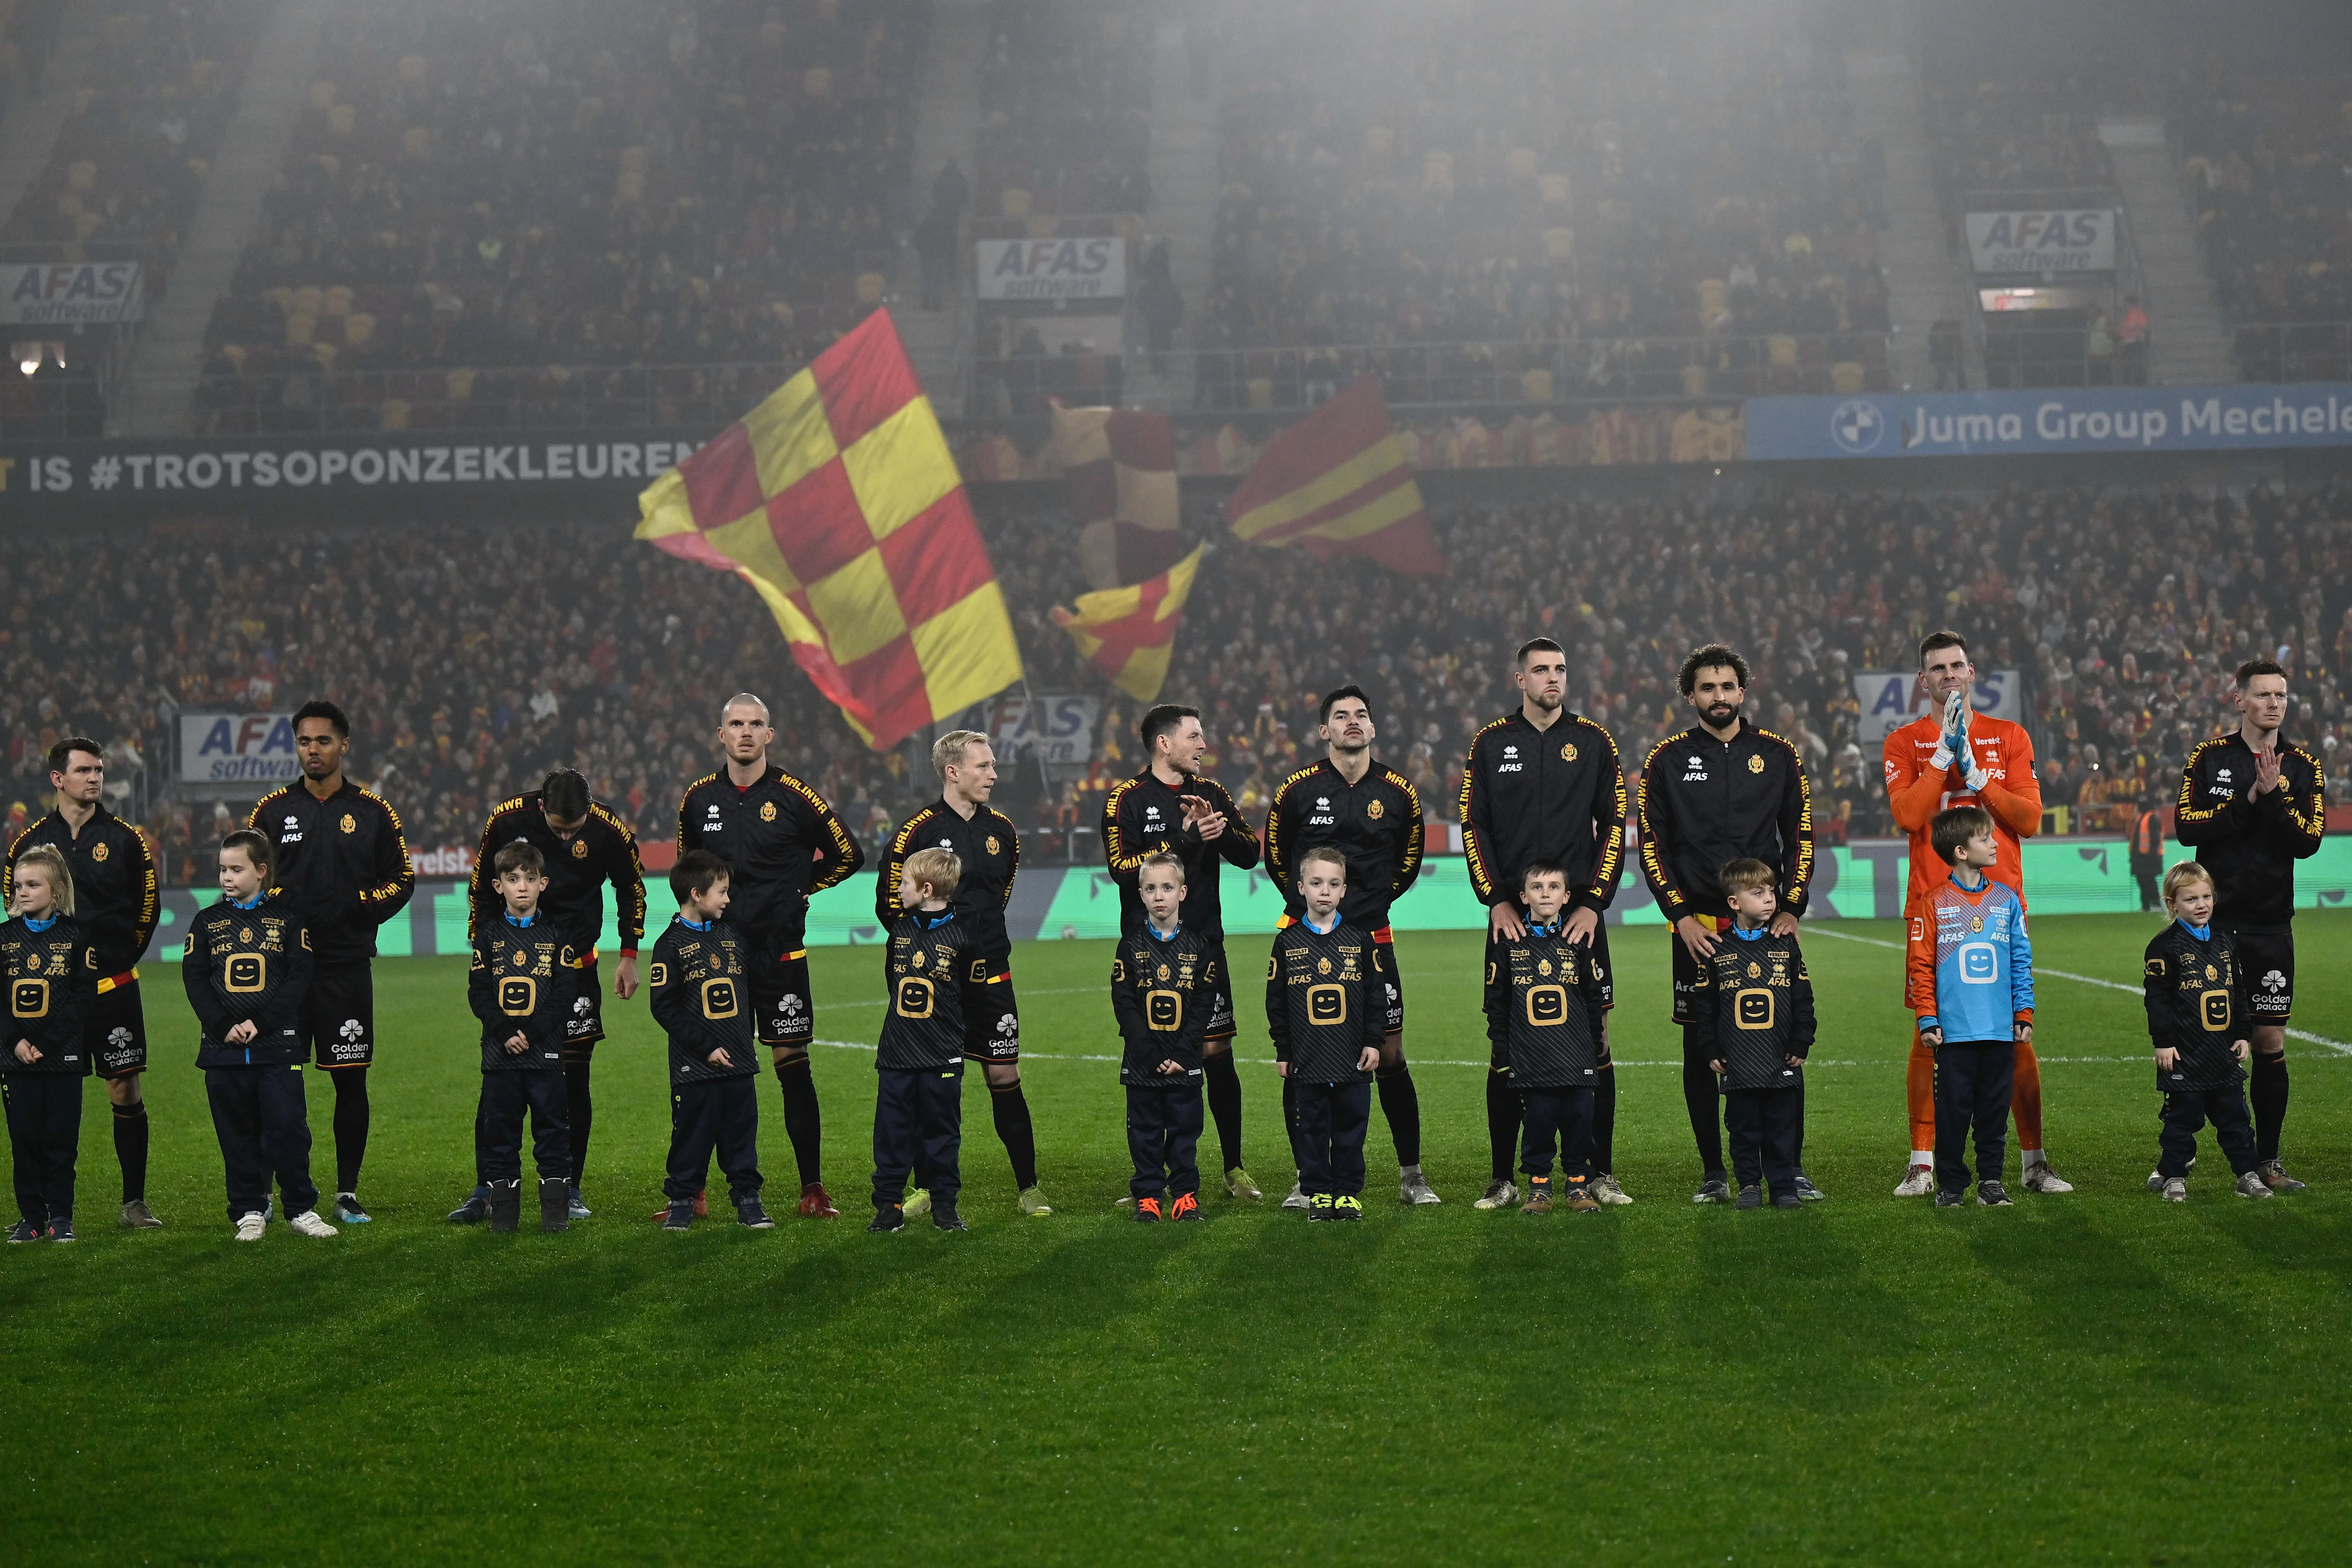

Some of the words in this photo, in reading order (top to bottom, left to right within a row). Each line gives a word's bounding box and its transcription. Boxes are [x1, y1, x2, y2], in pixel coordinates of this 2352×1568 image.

[1983, 214, 2100, 249] AFAS
[993, 241, 1110, 276] AFAS
[11, 266, 129, 303] AFAS
[21, 301, 121, 324] software
[1907, 404, 2022, 448] Juma
[2037, 401, 2167, 445] Group
[29, 455, 73, 492] IS
[1872, 674, 2005, 716] AFS
[198, 717, 296, 756] AFA
[1974, 736, 2002, 745] Verelst.
[1498, 763, 1523, 773] AFAS
[1683, 772, 1708, 782] AFAS
[1274, 765, 1319, 805] MALINWA
[779, 774, 829, 815] MALINWA
[1385, 771, 1421, 818] MALINWA
[2208, 786, 2235, 797] AFAS
[1106, 778, 1139, 818] MALINWA
[589, 803, 632, 844] MALINWA
[1309, 816, 1335, 826] AFAS
[703, 822, 723, 833] AFAS
[894, 808, 934, 854] MALINWA
[1143, 823, 1166, 834] AFAS
[281, 832, 303, 844] AFAS
[1463, 830, 1489, 884] MALINWA
[1598, 824, 1623, 882] MALINWA
[138, 868, 156, 924] MALINWA
[1937, 931, 1966, 944] AFAS
[1990, 932, 2010, 943] AFAS
[211, 943, 233, 956] AFAS
[258, 941, 284, 952] AFAS
[937, 944, 957, 956] VERELST
[1714, 954, 1737, 962] VERELST
[43, 967, 71, 976] AFAS
[727, 965, 742, 974] AFAS
[894, 963, 907, 973] FAS
[683, 968, 707, 984] AFAS
[1287, 973, 1312, 986] AFAS
[1338, 971, 1362, 982] AFAS
[1511, 975, 1533, 986] FAS
[1767, 977, 1792, 987] AFAS
[1719, 978, 1741, 992] AFAS
[2179, 979, 2203, 990] AFAS
[2251, 993, 2291, 1005] Golden
[1386, 1006, 1402, 1018] den
[2256, 1003, 2287, 1011] palace
[567, 1017, 599, 1029] Golden
[772, 1016, 810, 1028] Golden
[567, 1025, 598, 1036] palace
[777, 1024, 809, 1036] palace
[331, 1042, 369, 1055] Golden
[103, 1047, 143, 1063] Golden
[336, 1051, 366, 1061] palace
[109, 1055, 140, 1069] palace
